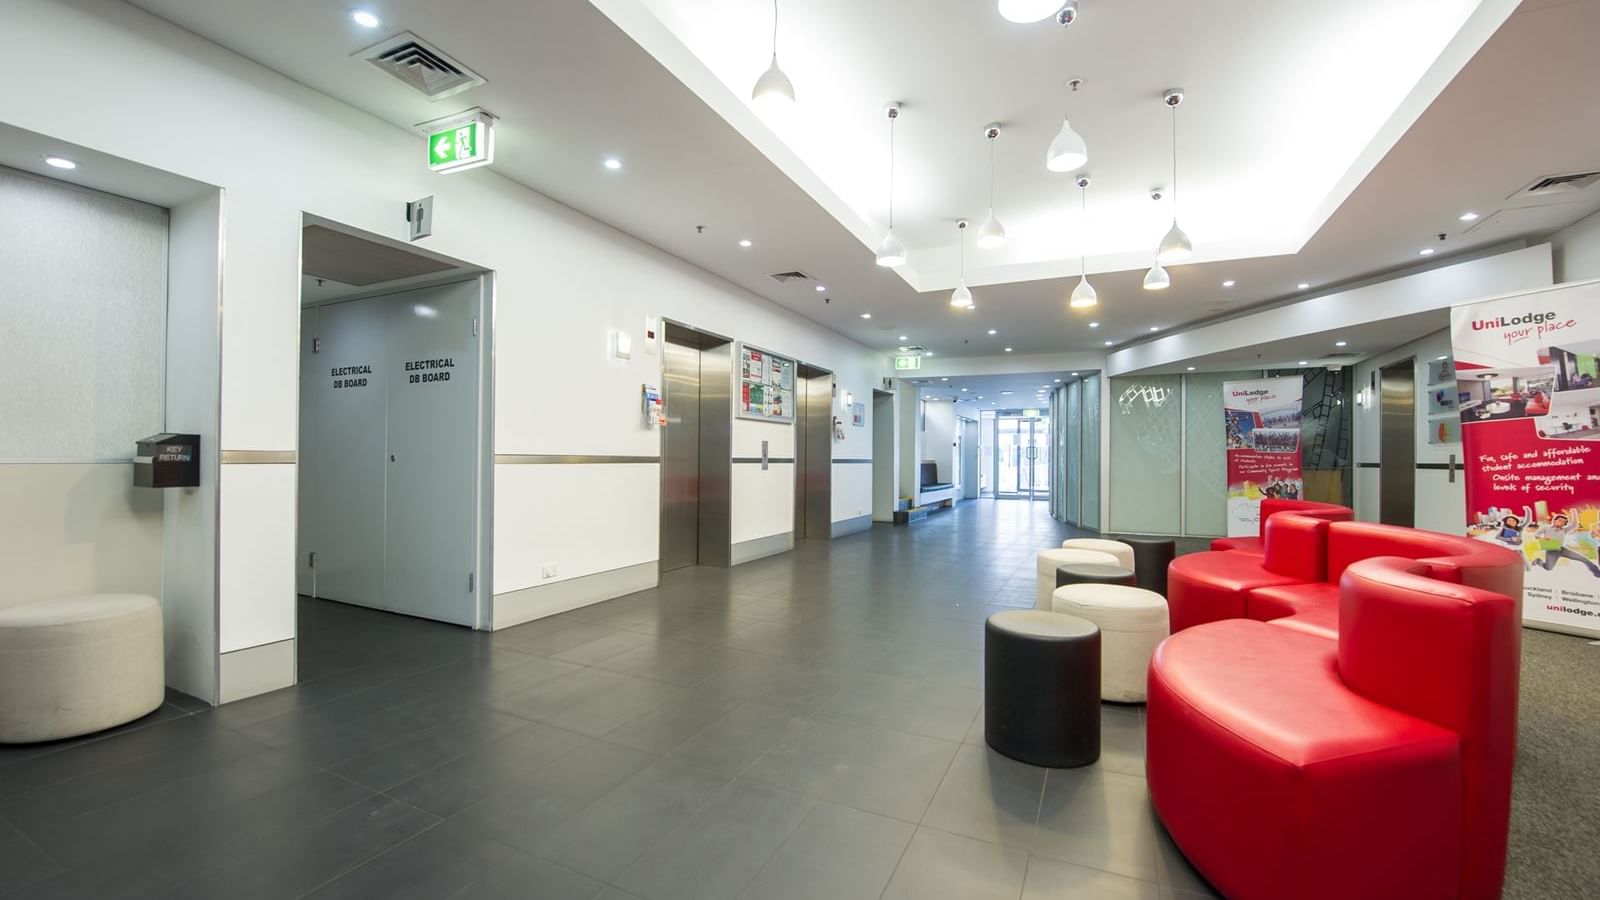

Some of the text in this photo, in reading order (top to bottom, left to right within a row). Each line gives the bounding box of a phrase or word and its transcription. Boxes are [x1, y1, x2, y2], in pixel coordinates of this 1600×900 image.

[1472, 311, 1556, 331] UniLodge
[1504, 318, 1577, 345] your place
[405, 358, 455, 371] ELECTRICAL
[331, 365, 372, 377] ELECTRICAL
[333, 378, 368, 389] DB BOARD
[409, 372, 451, 384] DB BOARD
[1232, 389, 1269, 397] UniLodge
[166, 445, 183, 453] KEY
[1479, 445, 1592, 463] Fun, safe and affordable
[1481, 457, 1584, 472] student accommodation
[1492, 473, 1520, 481] Onsite
[1525, 473, 1582, 485] management
[1493, 483, 1574, 495] levels of security
[1527, 592, 1552, 600] Sydney
[1561, 589, 1594, 598] Brisbane
